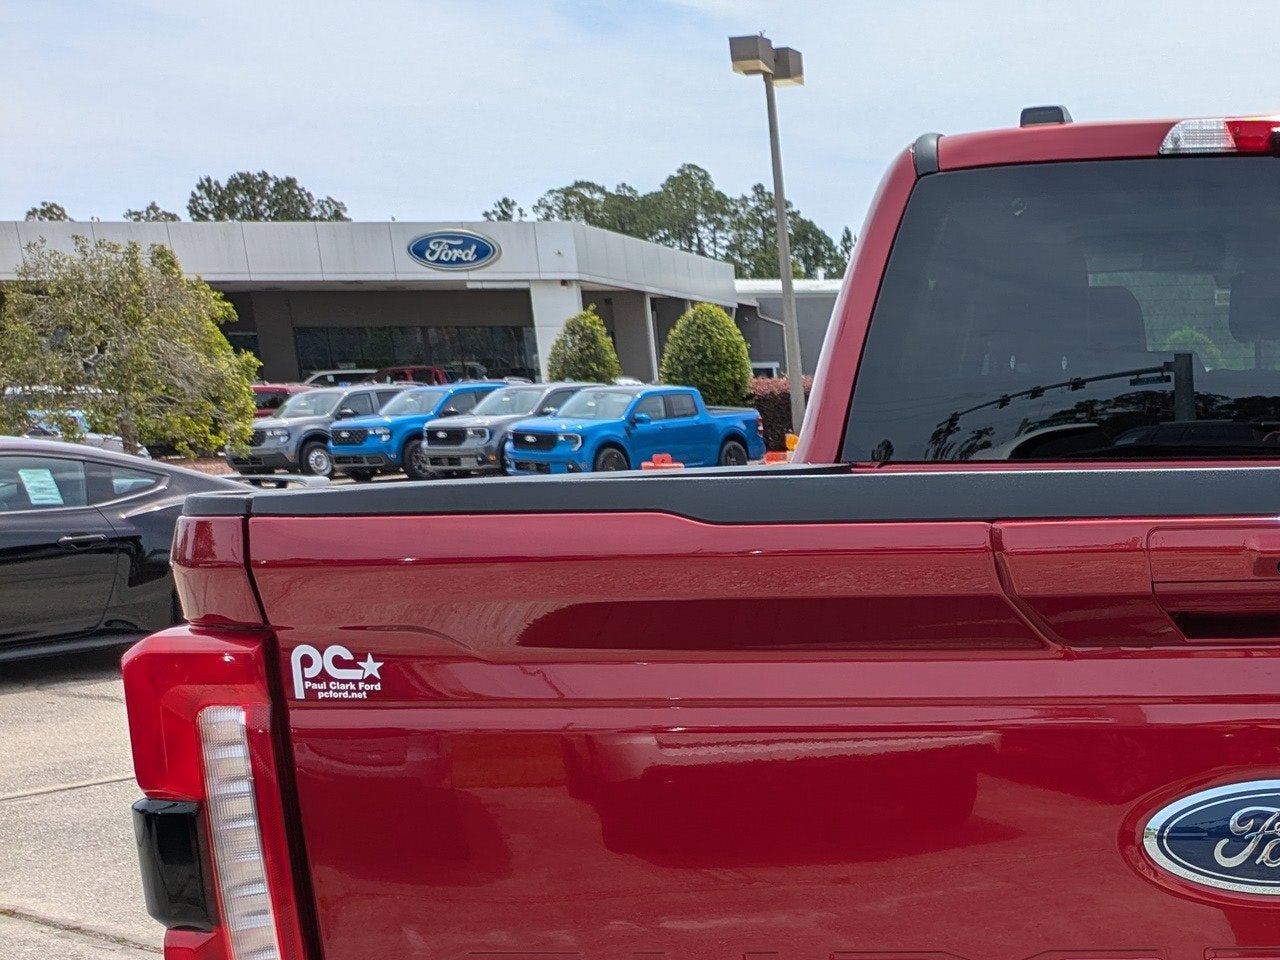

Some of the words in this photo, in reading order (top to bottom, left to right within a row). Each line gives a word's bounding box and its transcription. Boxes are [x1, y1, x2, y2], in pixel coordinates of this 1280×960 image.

[425, 238, 478, 262] Ford
[304, 681, 327, 690] Paul
[329, 681, 356, 690] Clark
[358, 682, 381, 690] Ford
[318, 690, 367, 699] pcford.net
